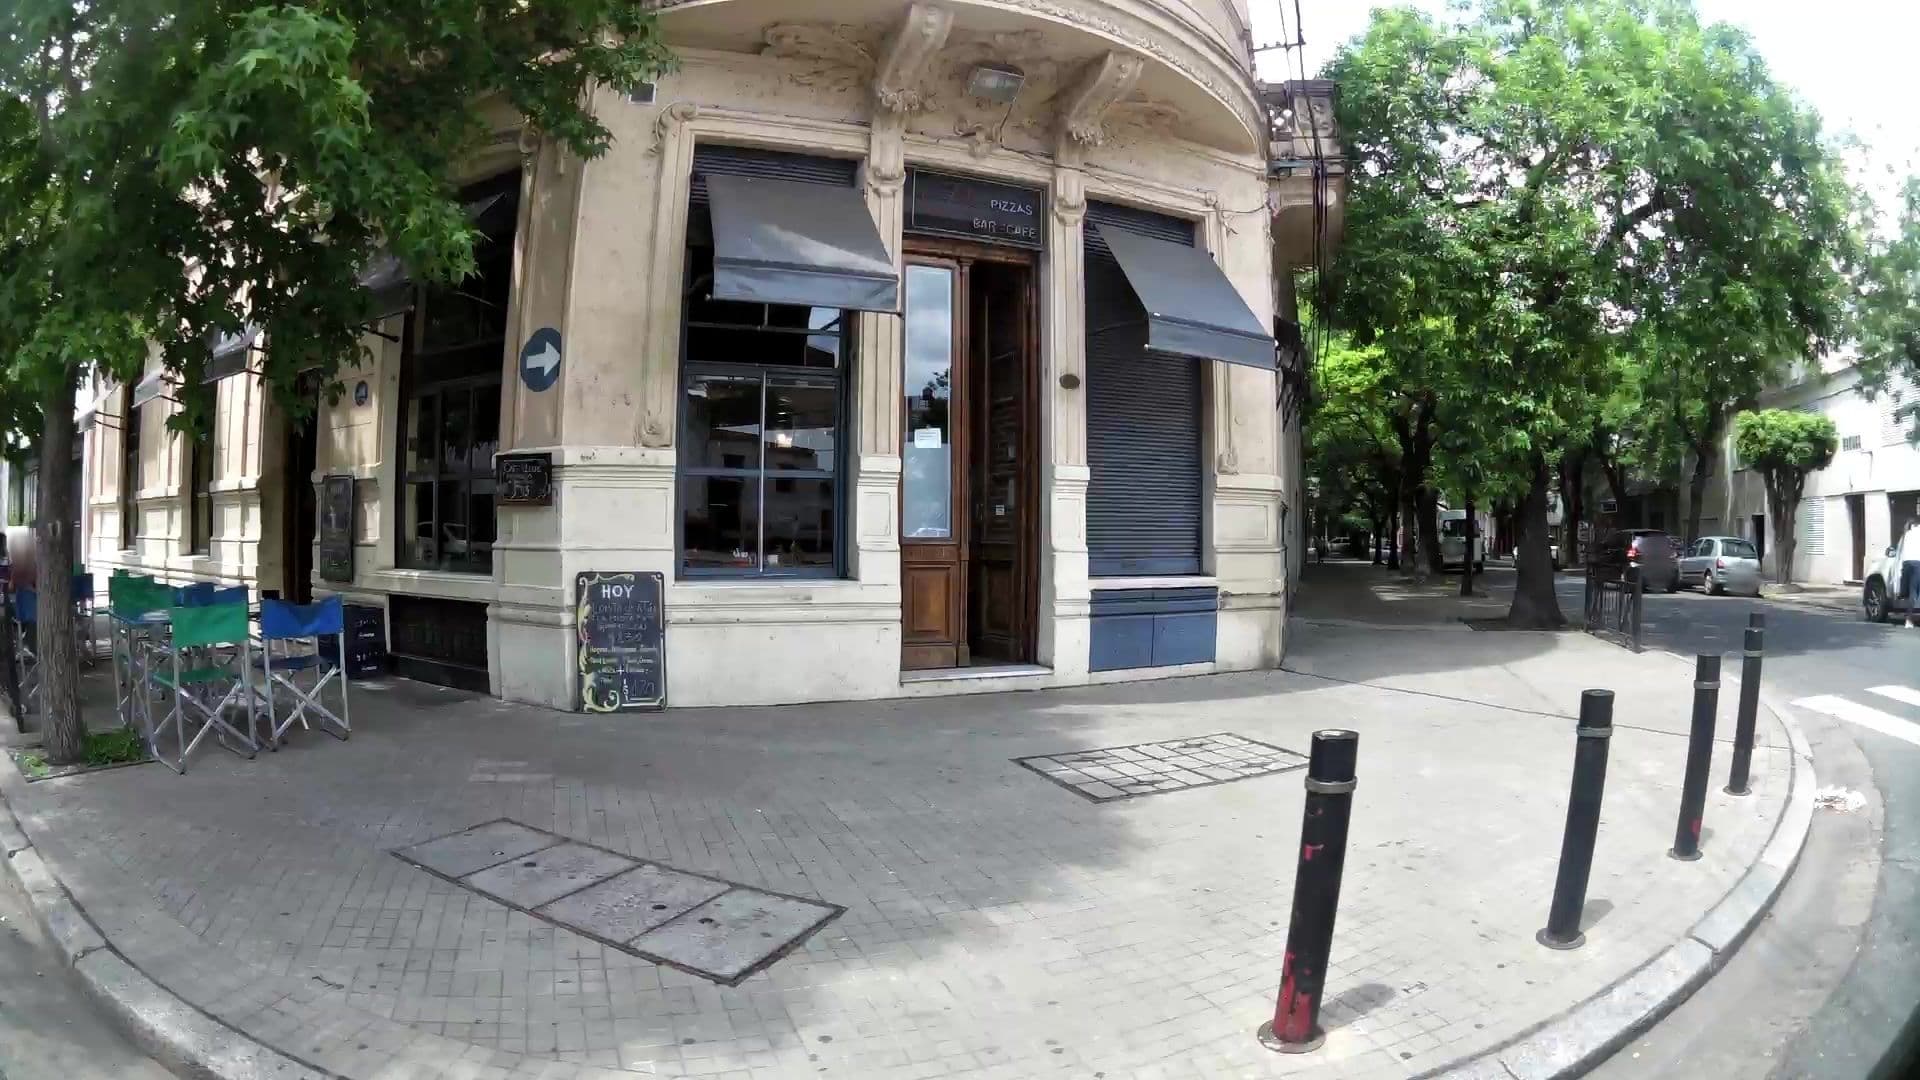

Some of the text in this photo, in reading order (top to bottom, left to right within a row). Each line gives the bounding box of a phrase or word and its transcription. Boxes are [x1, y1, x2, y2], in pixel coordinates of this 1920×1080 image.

[990, 199, 1033, 216] PIZZAS
[973, 218, 997, 233] BAR
[601, 584, 635, 599] HOY
